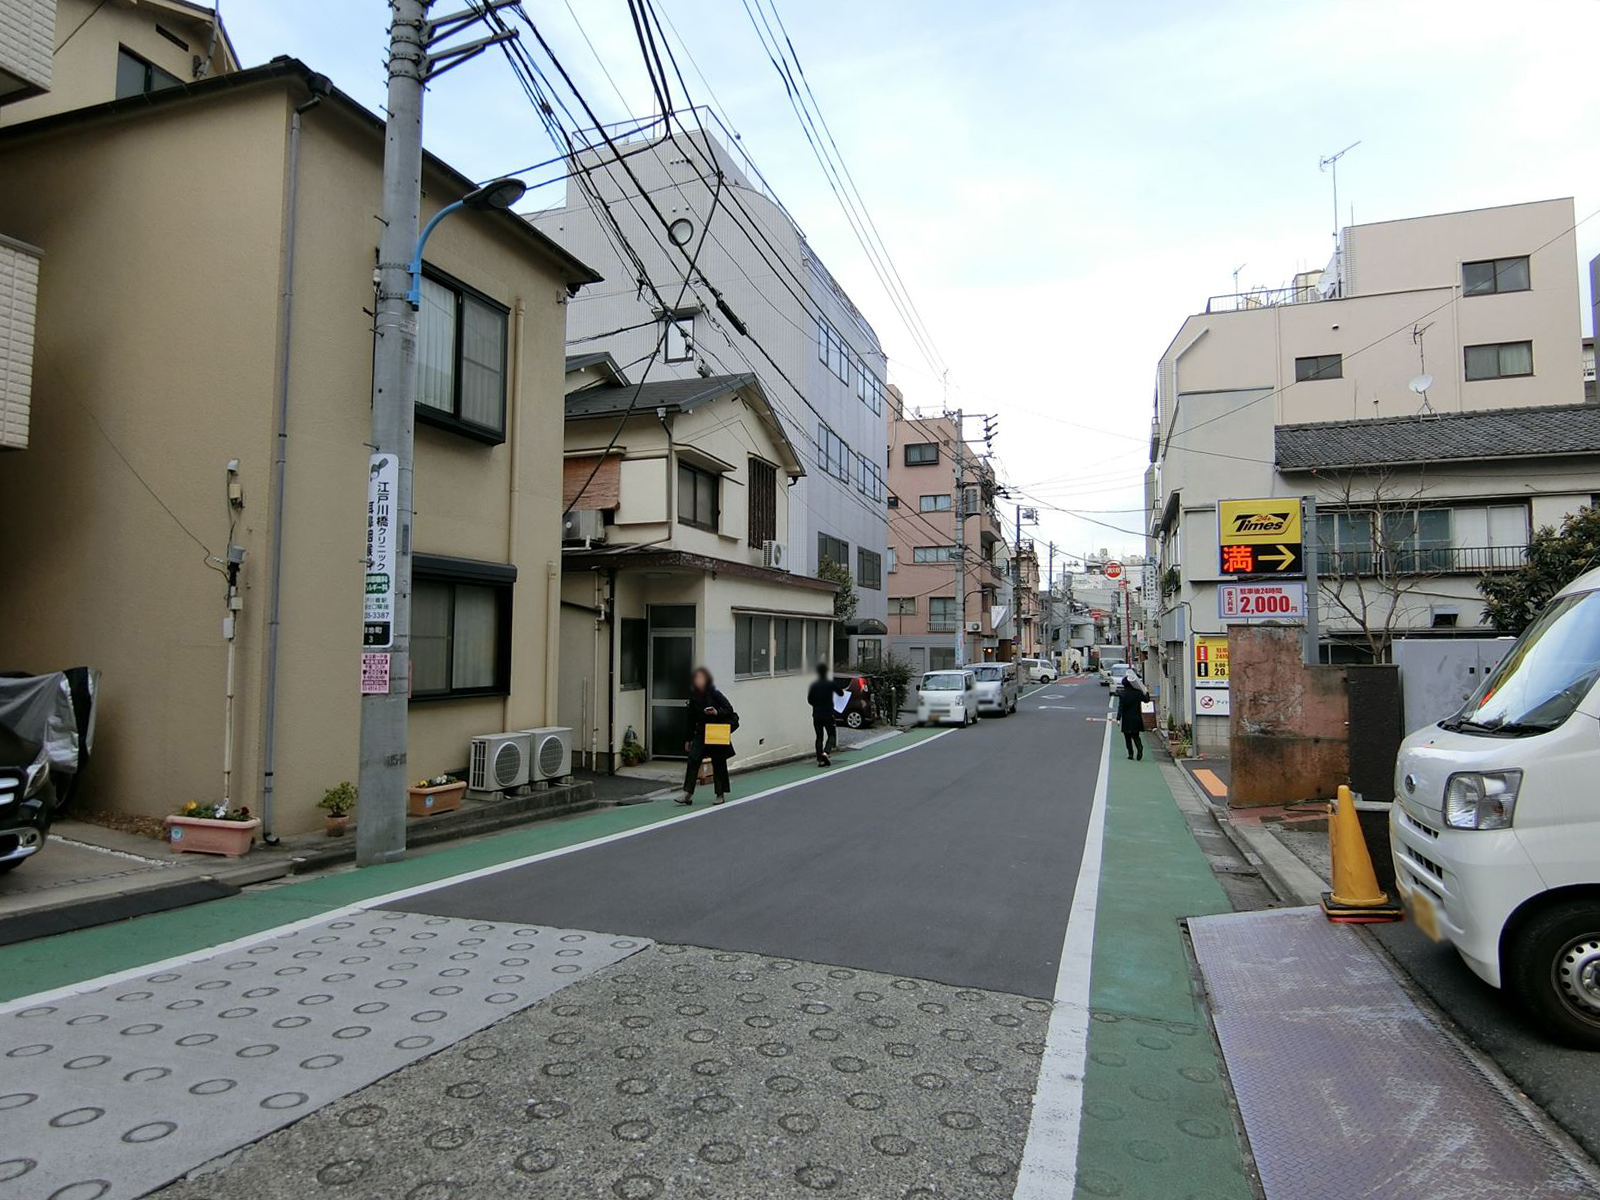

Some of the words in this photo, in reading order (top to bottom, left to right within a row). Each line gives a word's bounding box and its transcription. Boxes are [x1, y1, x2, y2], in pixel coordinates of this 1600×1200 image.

[377, 481, 389, 571] 江戸川橋クリニック
[1235, 519, 1284, 533] Times
[1223, 545, 1253, 573] 満
[368, 635, 374, 643] 3
[1214, 667, 1226, 676] 20
